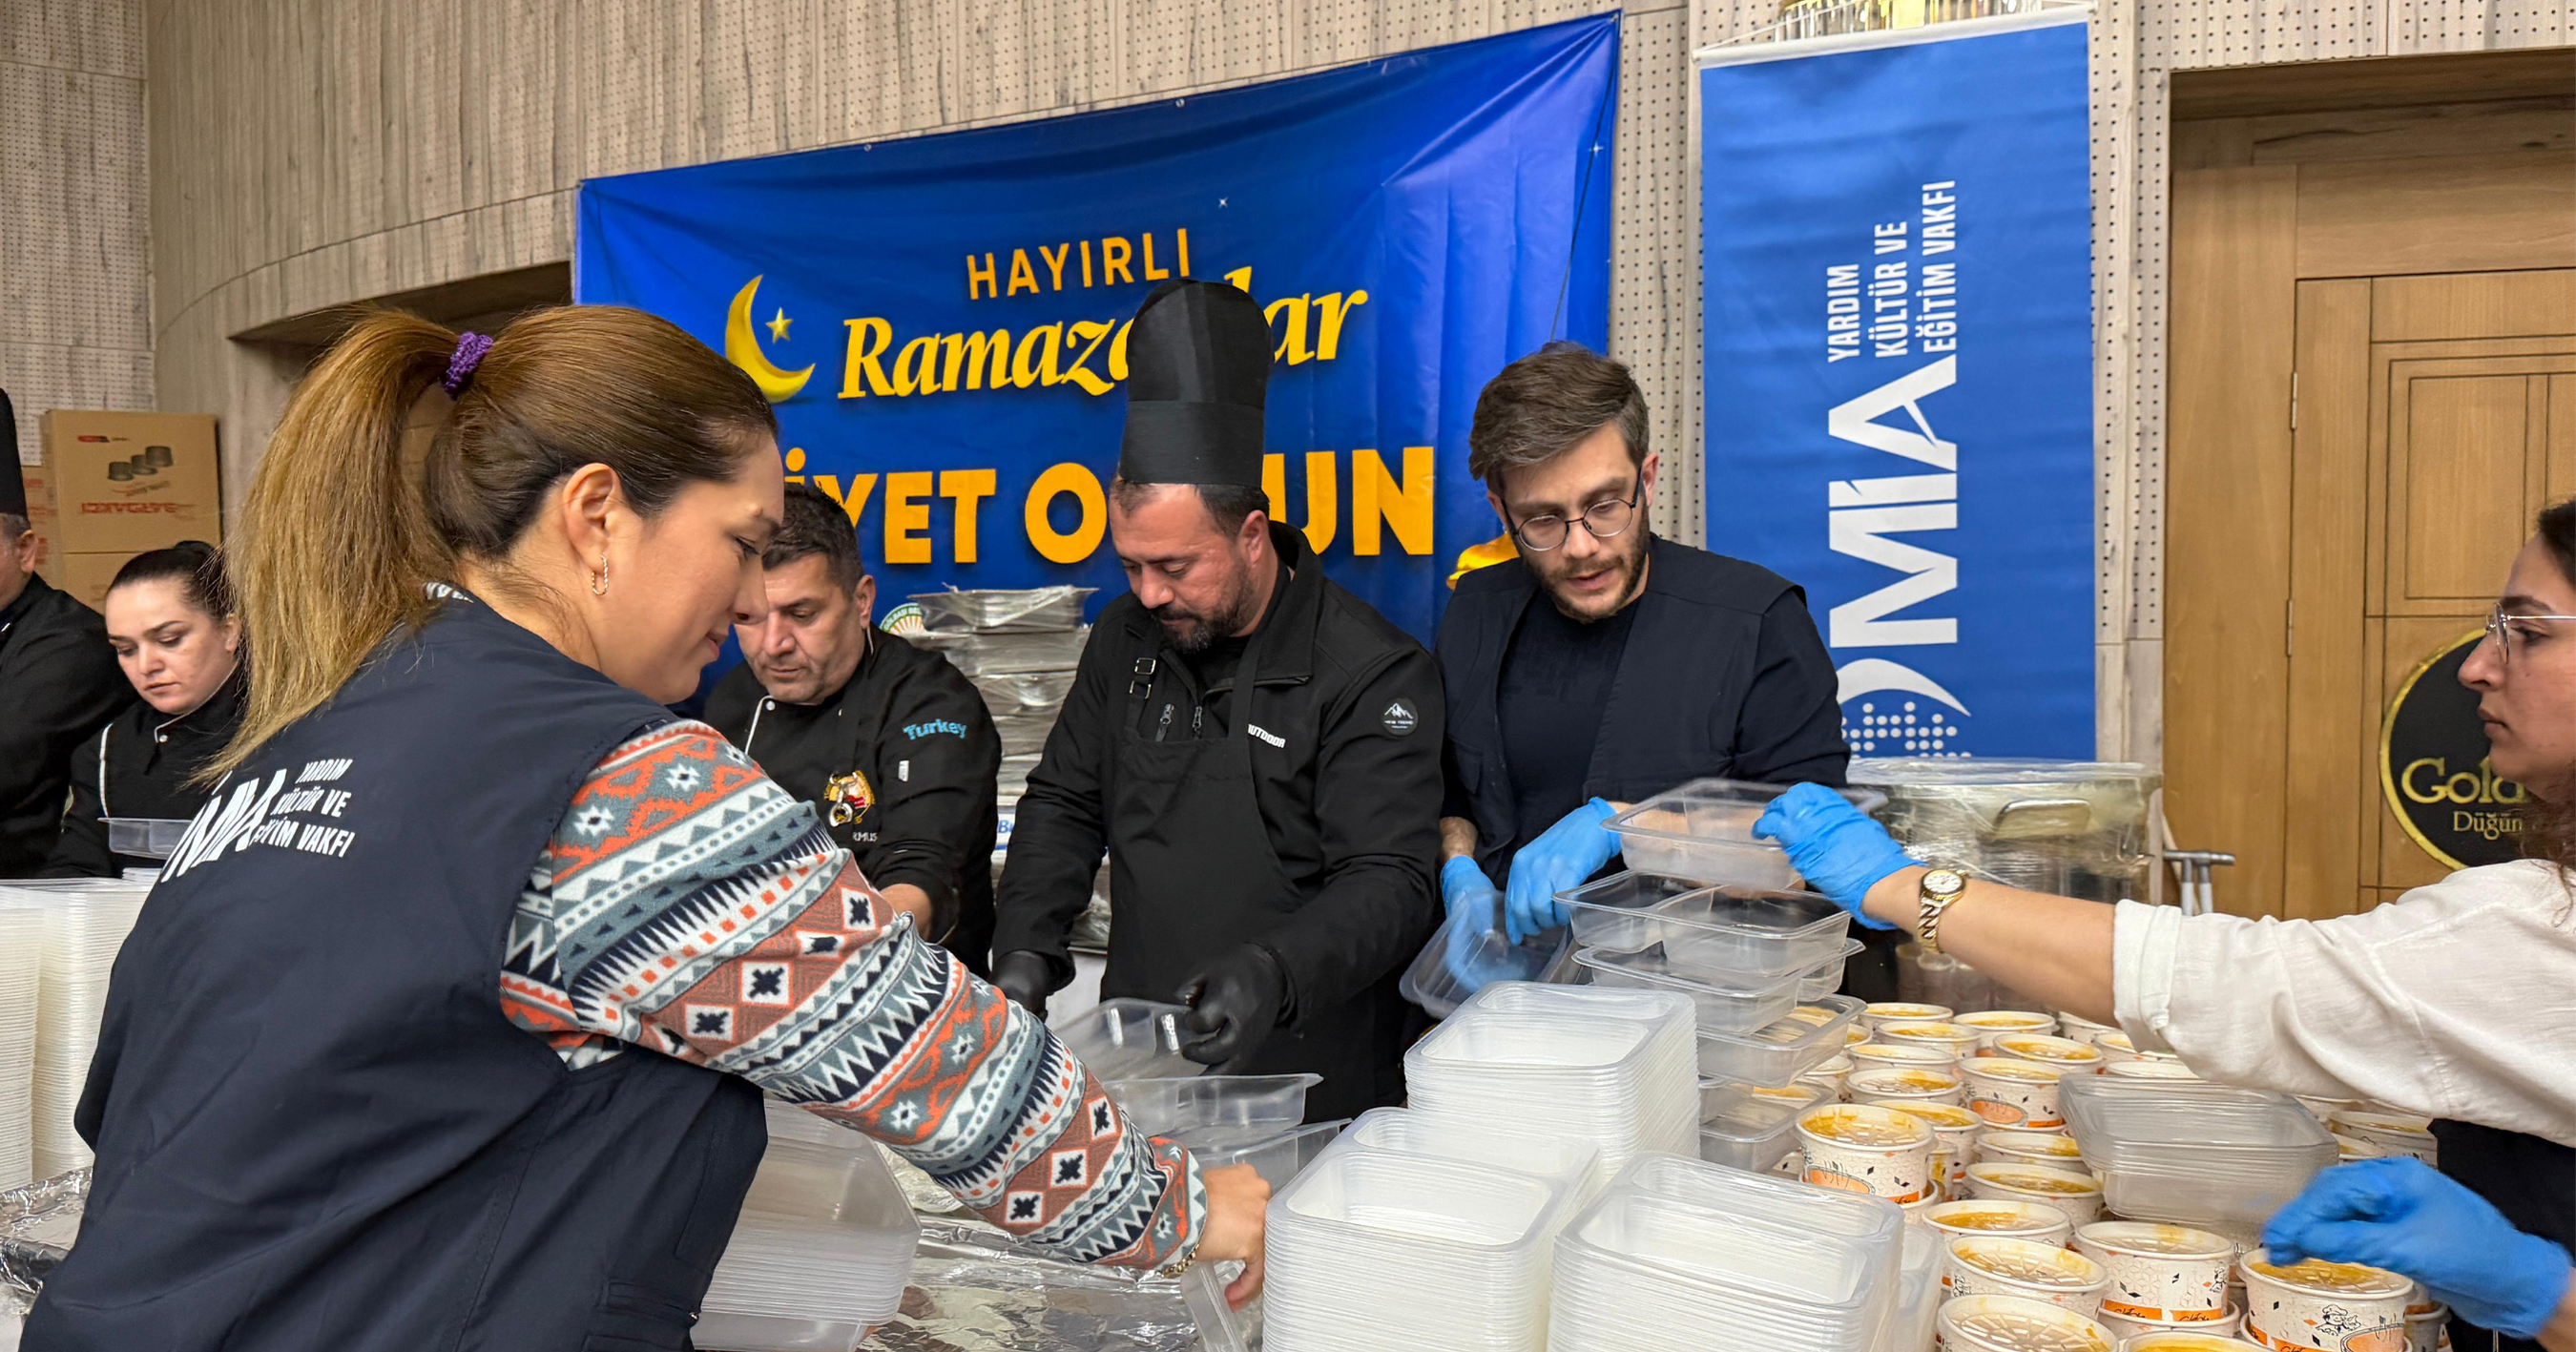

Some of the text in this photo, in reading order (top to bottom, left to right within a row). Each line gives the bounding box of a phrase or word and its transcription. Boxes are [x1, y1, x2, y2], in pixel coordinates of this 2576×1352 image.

[965, 227, 1191, 301] HAYIRLI
[1867, 220, 1908, 359] KÜLTÜR VE
[1915, 179, 1957, 353] EĞİTİM VAKFI
[837, 265, 1368, 398] Ramazar
[1826, 263, 1860, 364] YARDIM
[1024, 445, 1434, 565] OUN
[903, 718, 966, 740] Turkey
[296, 823, 356, 859] VAKFI
[321, 789, 352, 818] VE
[2453, 811, 2523, 841] Düğün
